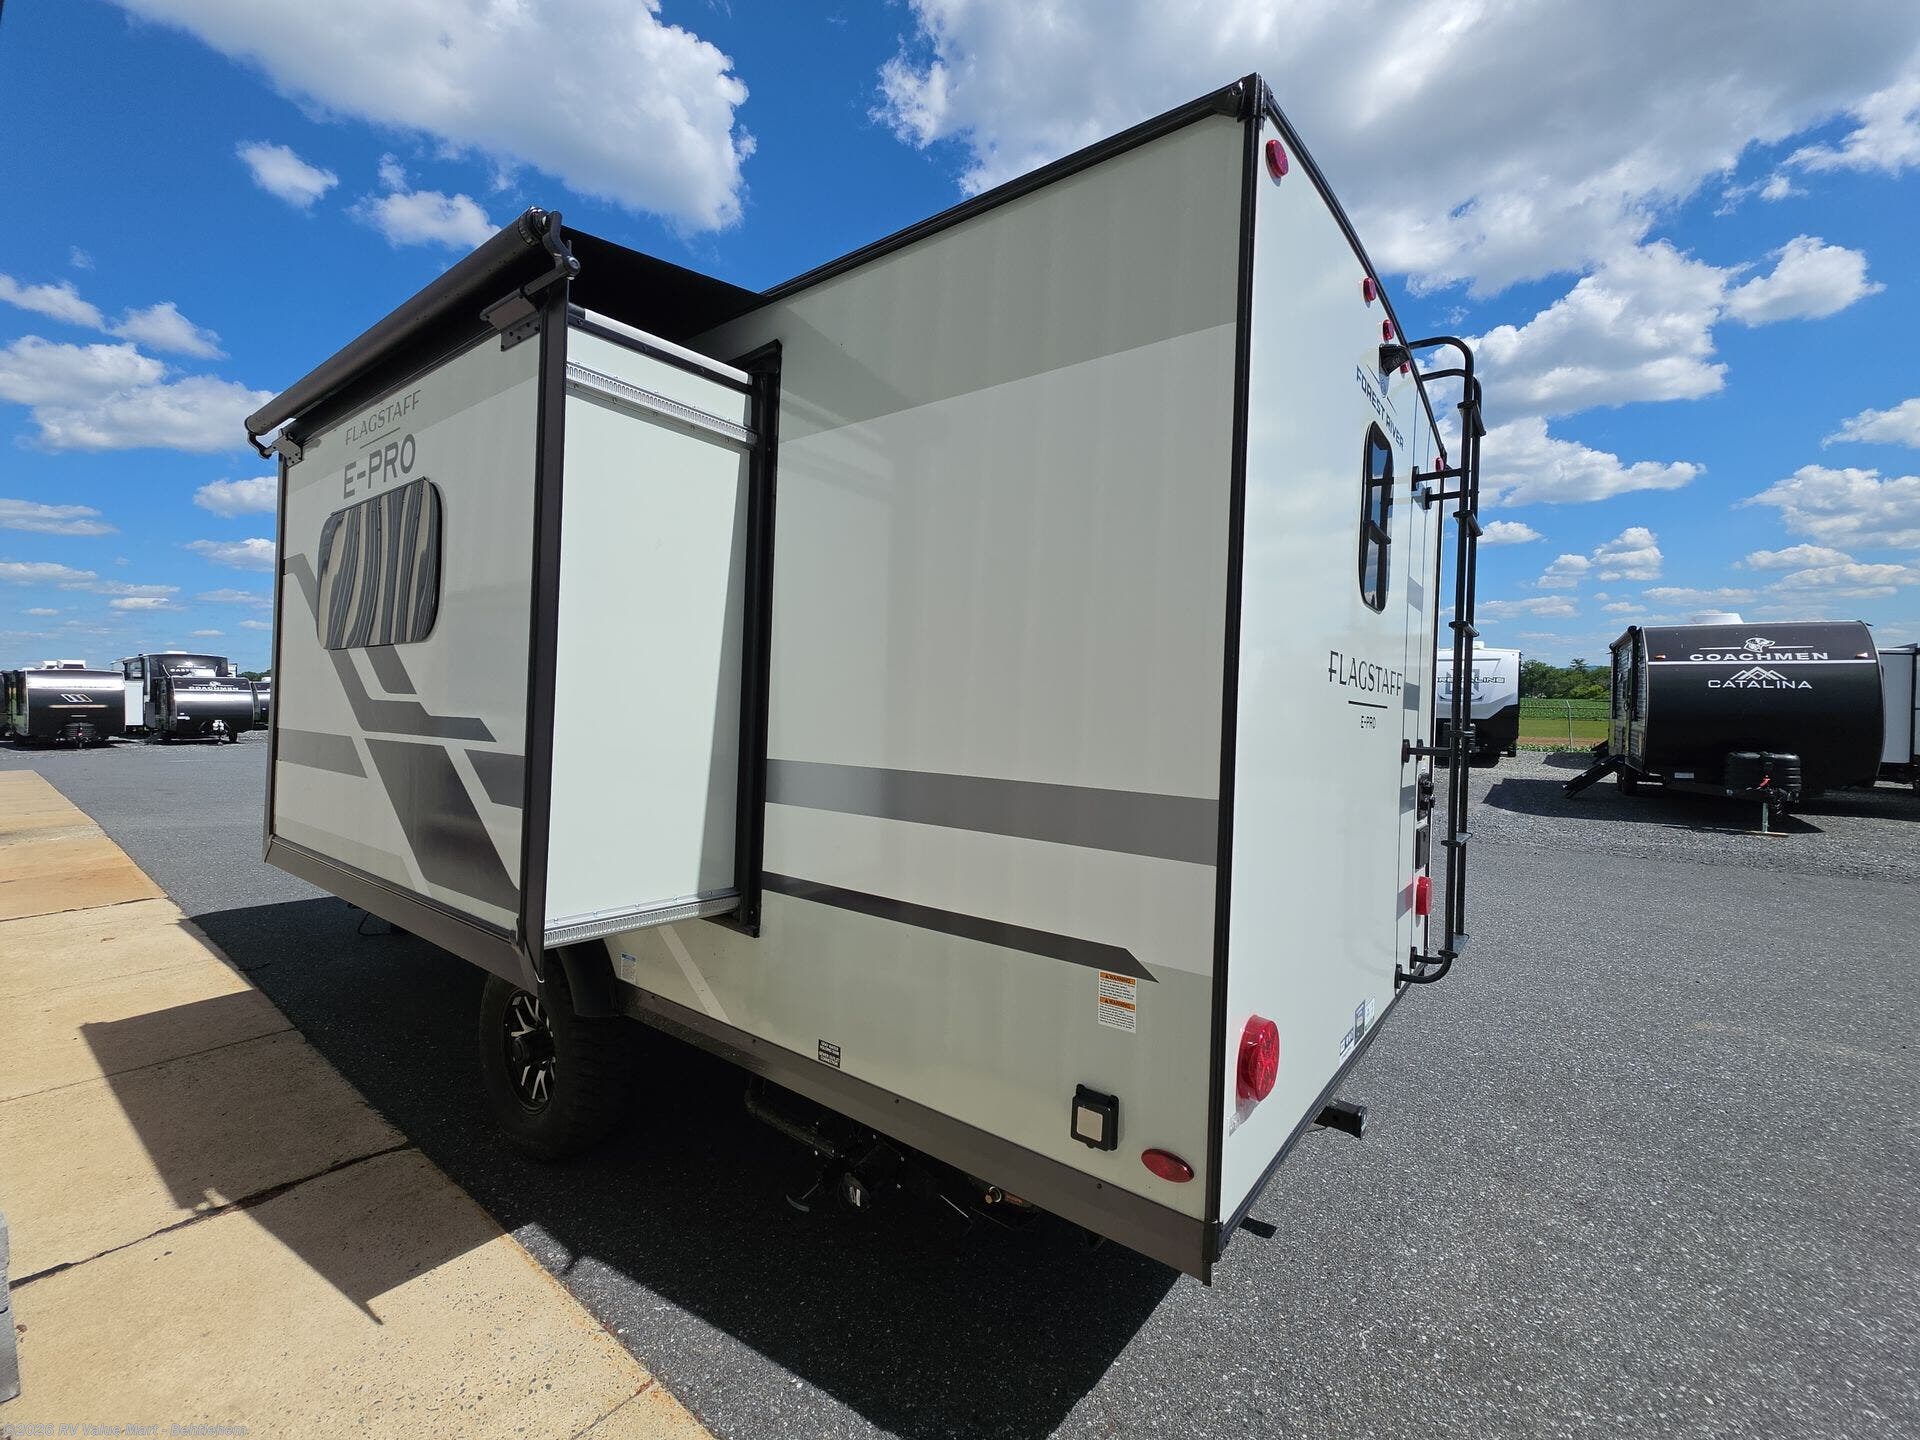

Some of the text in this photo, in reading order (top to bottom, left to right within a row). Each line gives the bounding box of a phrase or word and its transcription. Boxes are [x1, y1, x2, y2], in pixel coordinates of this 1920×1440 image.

[345, 389, 421, 445] FLAGSTAFF
[1356, 364, 1404, 451] FOREST RIVER
[343, 433, 416, 500] E-PRO
[1328, 650, 1403, 696] FLAGSTAFF
[1689, 652, 1829, 661] COACHMEN
[1707, 680, 1813, 689] CATALINA
